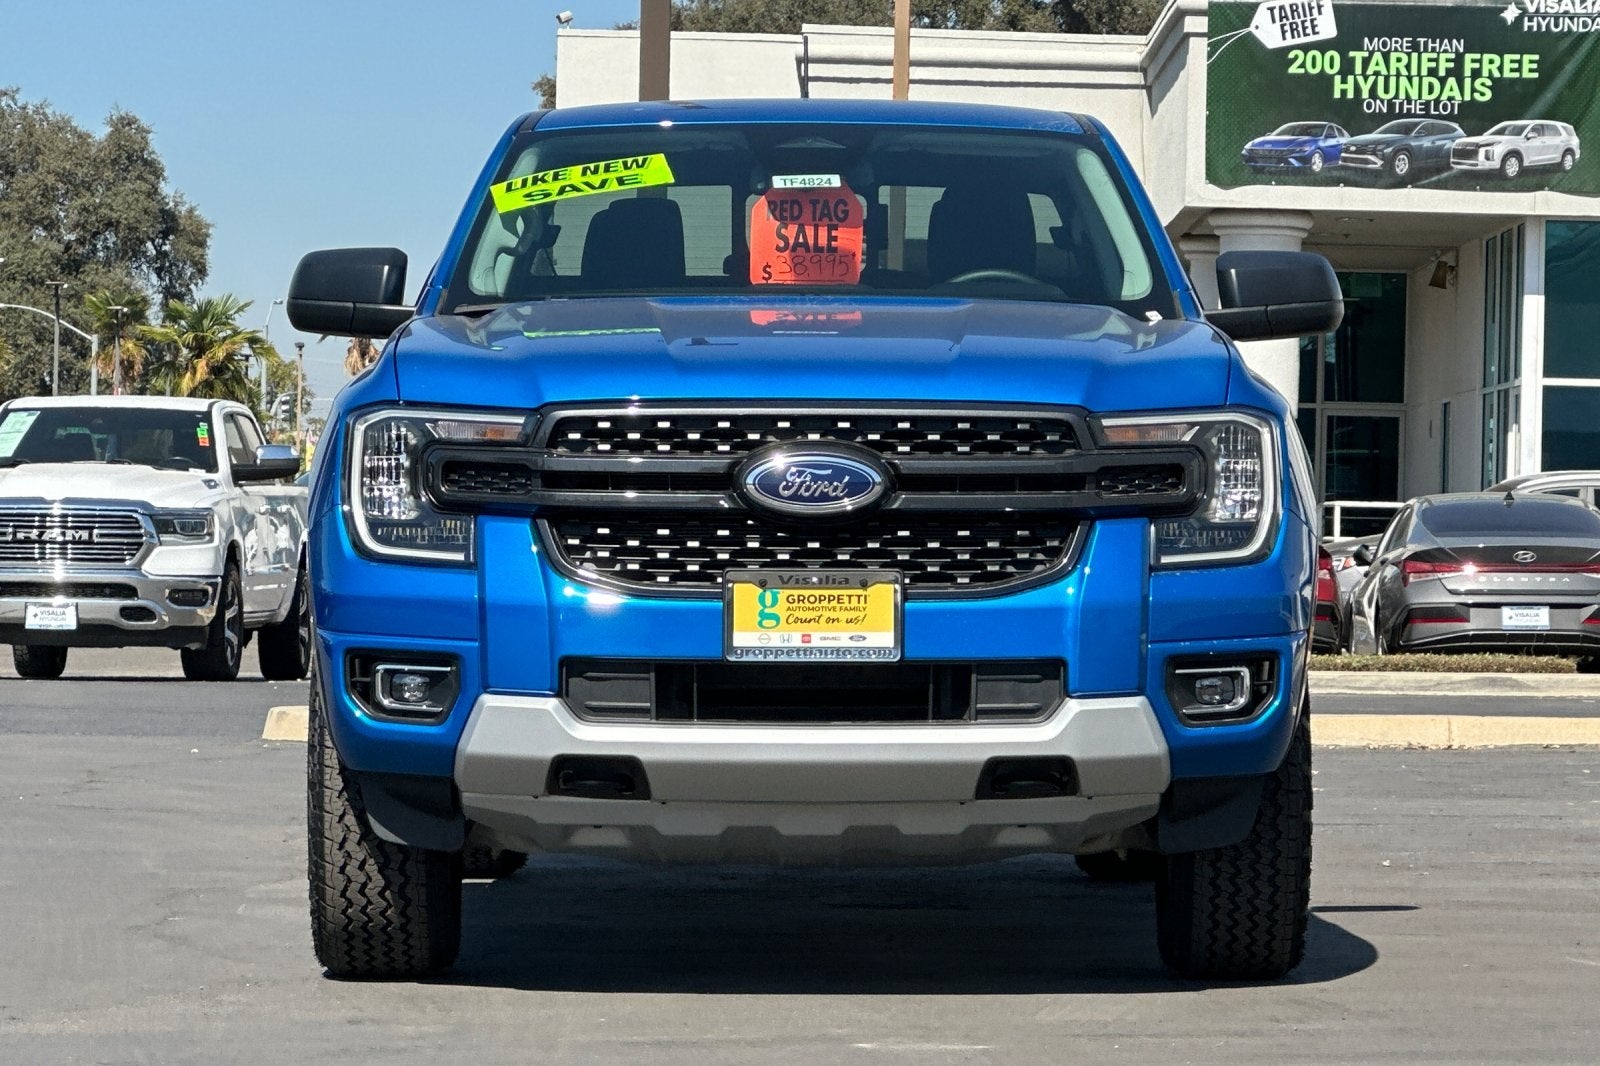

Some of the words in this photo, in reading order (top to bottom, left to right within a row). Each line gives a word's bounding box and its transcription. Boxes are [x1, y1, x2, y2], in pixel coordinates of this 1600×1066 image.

[1266, 0, 1325, 24] TARIFF
[1279, 17, 1320, 41] FREE
[1364, 37, 1413, 52] MORE
[1417, 38, 1464, 53] THAN
[1287, 50, 1340, 75] 200
[1350, 52, 1455, 77] TARIFF
[1465, 54, 1540, 78] FREE
[1333, 75, 1493, 102] HYUNDAIS
[1363, 99, 1388, 114] ON
[1392, 99, 1426, 115] THE
[1430, 100, 1461, 115] LOT
[505, 169, 571, 193] LIKE
[581, 155, 653, 176] NEW
[780, 177, 833, 187] TF4824
[522, 173, 646, 202] SAVE
[767, 199, 803, 223] RED
[809, 198, 849, 223] TAG
[775, 222, 839, 254] SALE
[778, 466, 850, 498] Ford
[16, 528, 89, 541] RAM
[778, 574, 850, 586] Visalia
[785, 593, 868, 605] GROPPETTI
[786, 613, 824, 625] Count
[825, 617, 842, 625] on
[846, 613, 868, 625] us!
[734, 648, 894, 659] groppettiauto.com
